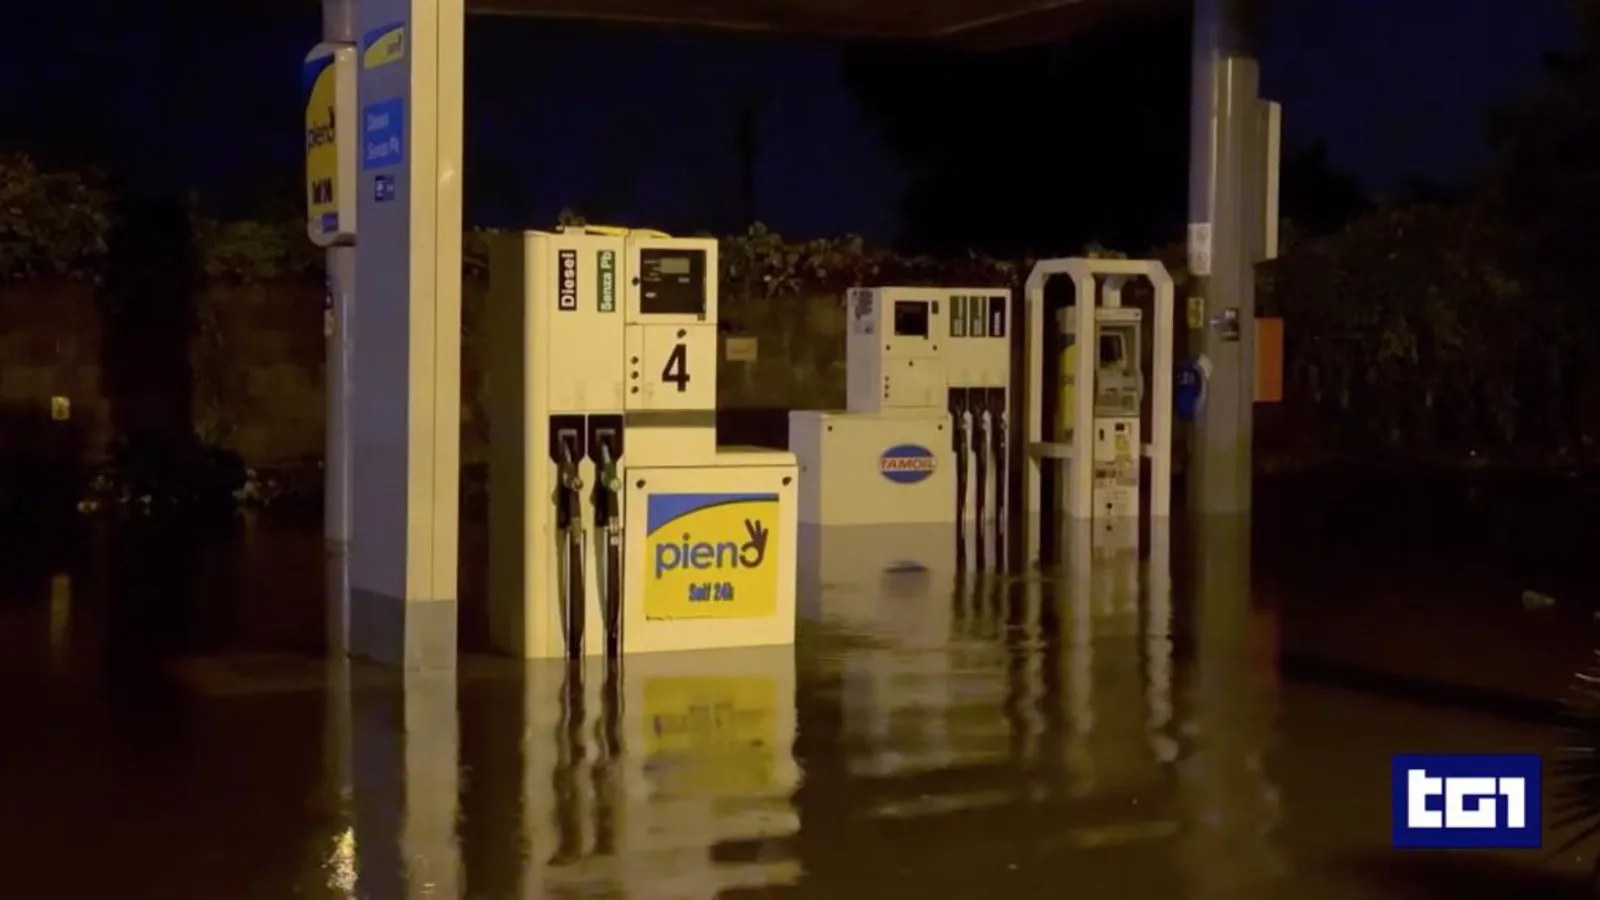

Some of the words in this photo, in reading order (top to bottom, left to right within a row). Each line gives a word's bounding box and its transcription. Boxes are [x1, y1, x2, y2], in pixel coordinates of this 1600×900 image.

[561, 252, 575, 308] Diesel
[601, 251, 613, 269] Pb
[601, 274, 613, 311] Senza
[662, 343, 691, 392] 4
[881, 458, 936, 470] TAMOIL
[655, 518, 769, 580] pieno
